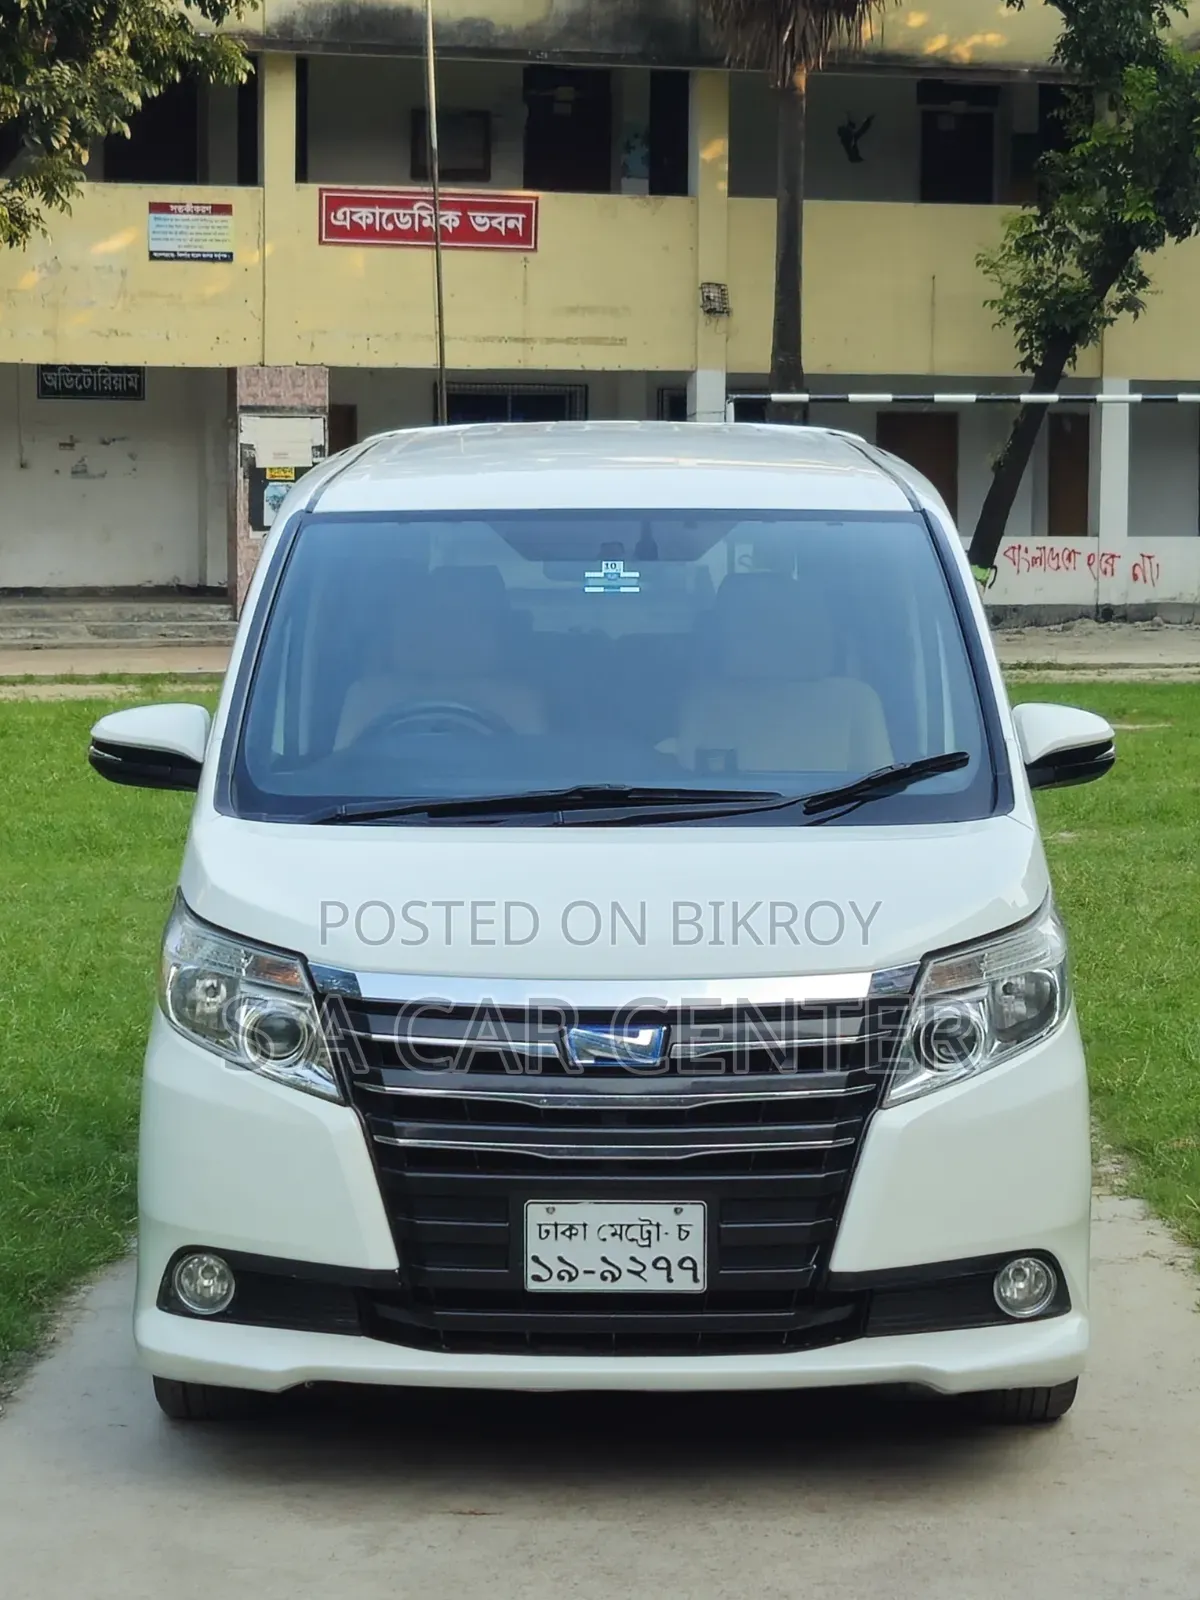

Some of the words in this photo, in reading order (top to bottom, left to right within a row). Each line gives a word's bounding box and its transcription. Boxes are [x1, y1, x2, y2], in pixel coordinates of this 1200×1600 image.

[331, 202, 462, 234] একাডেমিক
[467, 212, 527, 237] ভবন
[605, 562, 617, 570] 10
[537, 1222, 588, 1242] ঢাকা
[531, 1255, 701, 1284] ১৯-৯২৭৭
